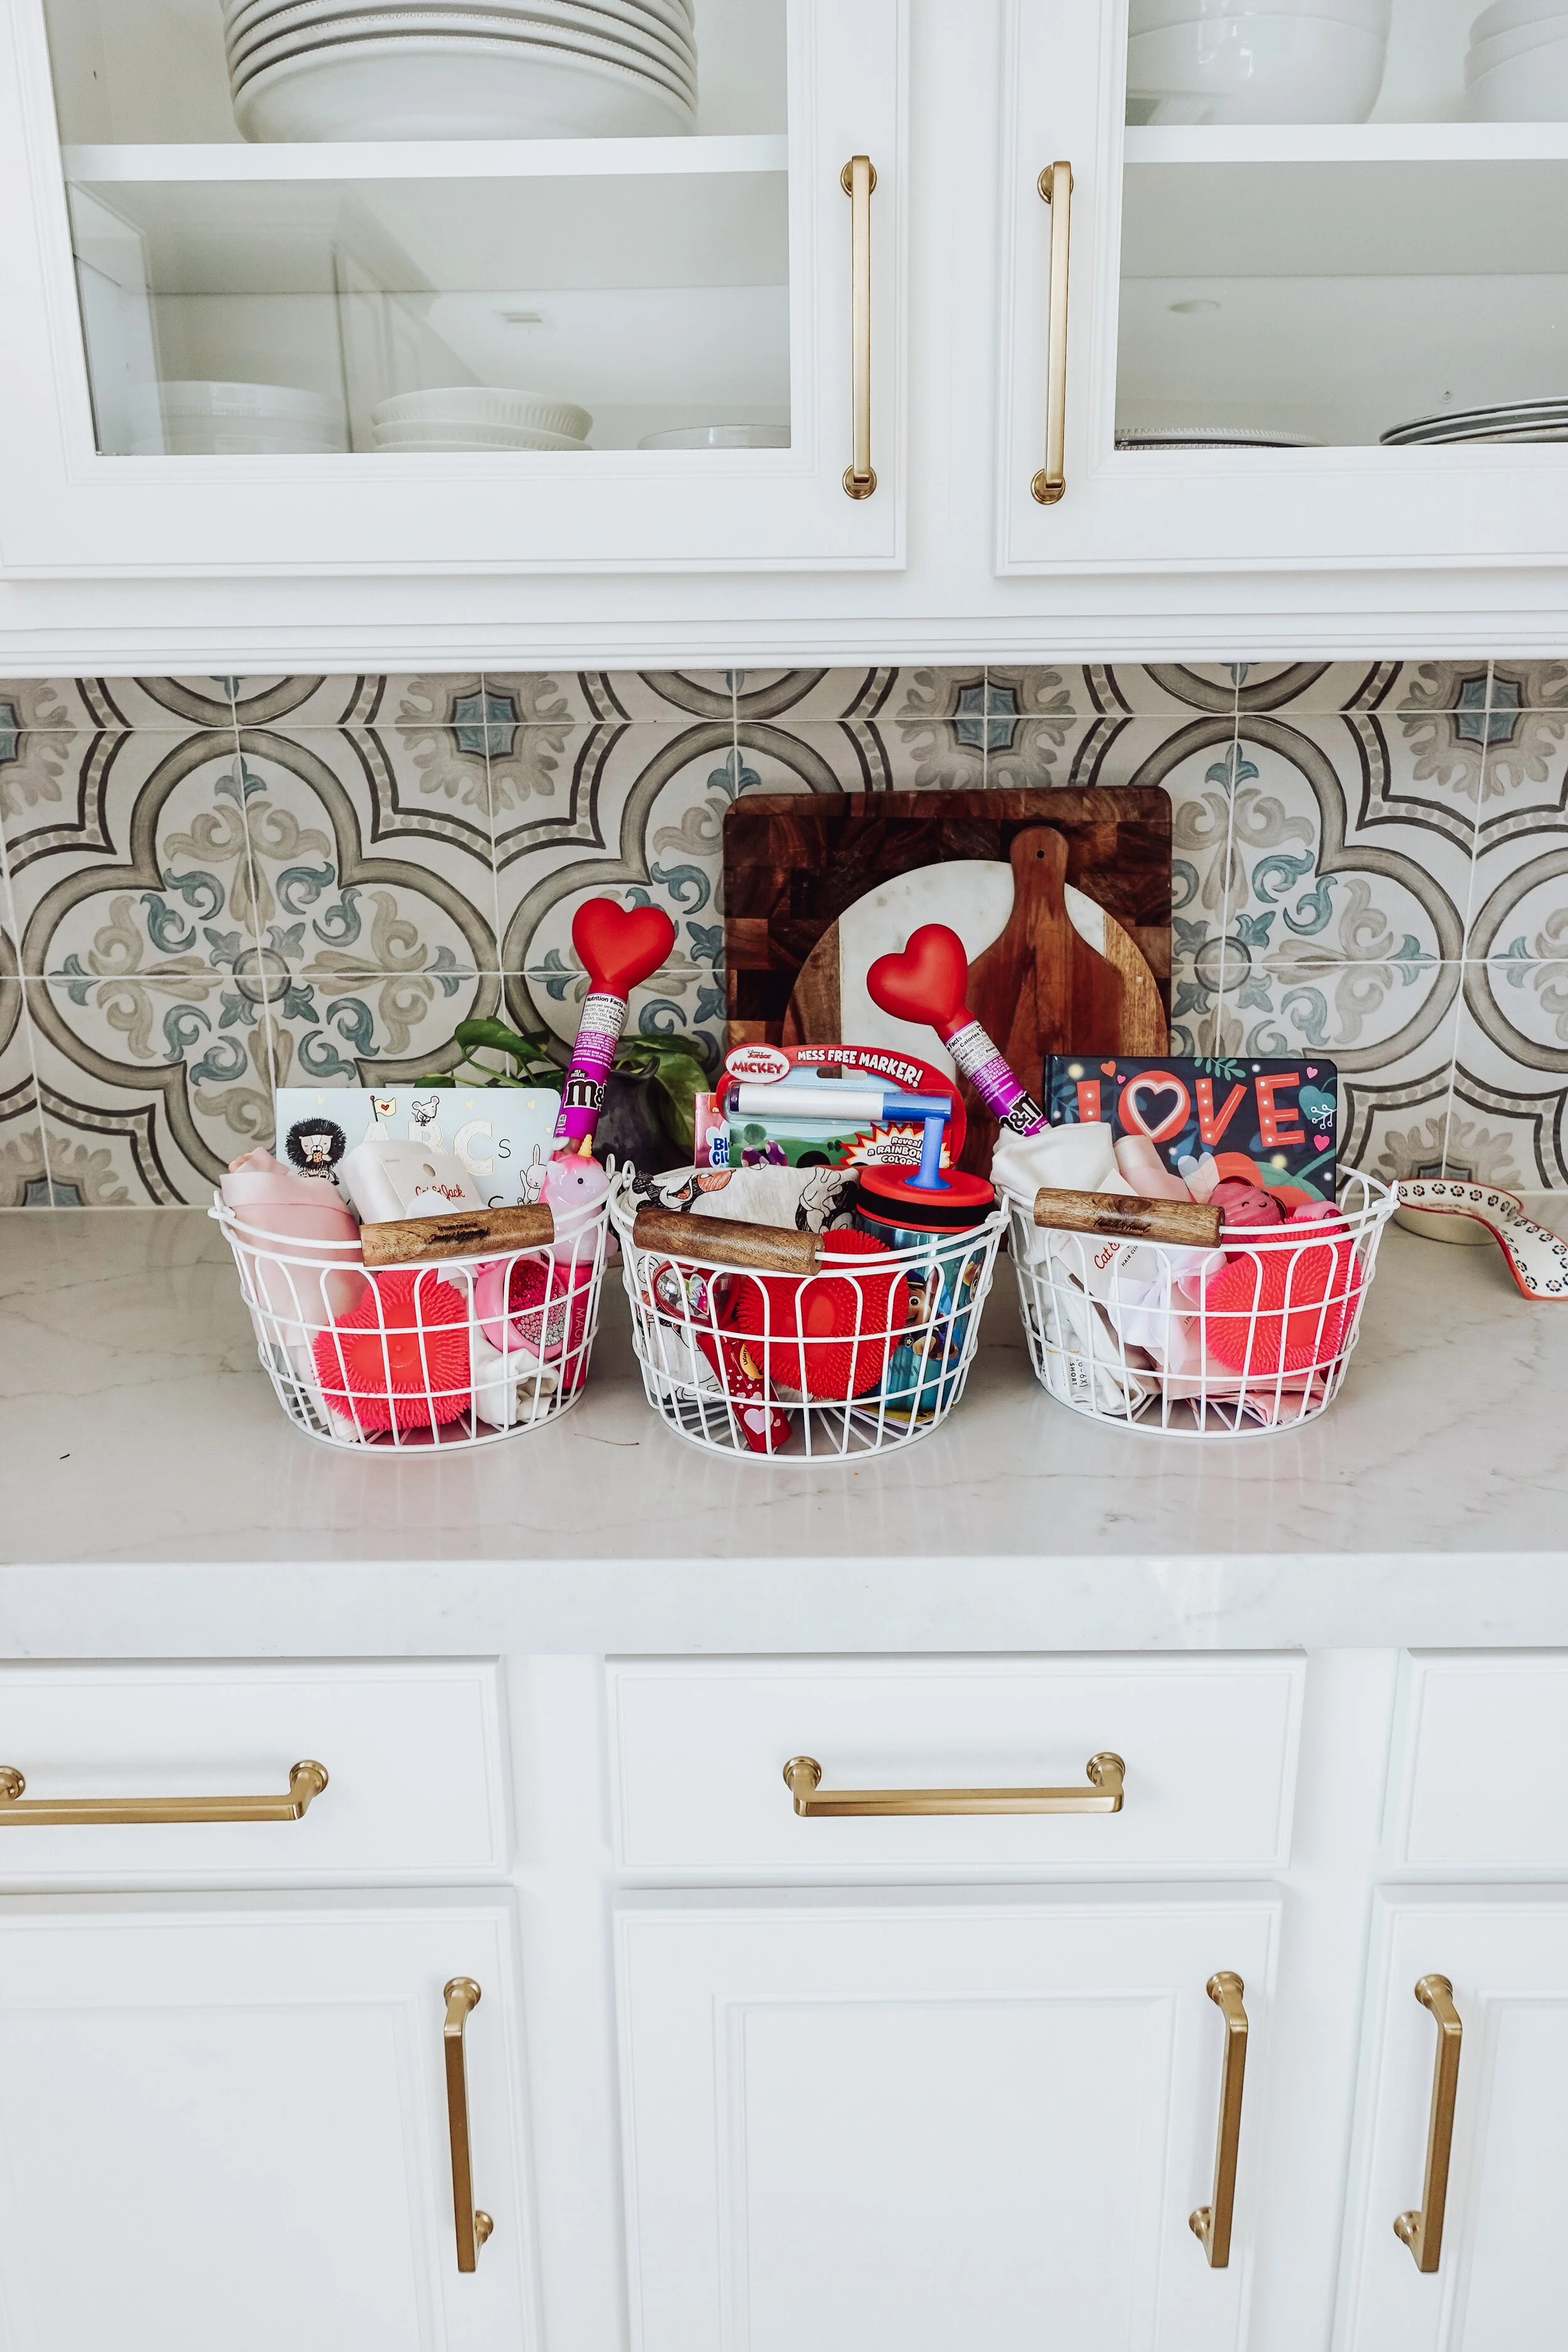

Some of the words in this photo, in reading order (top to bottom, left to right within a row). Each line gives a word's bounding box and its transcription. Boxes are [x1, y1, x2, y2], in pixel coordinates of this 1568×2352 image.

[948, 1036, 962, 1049] Facts
[960, 1032, 980, 1047] Calories
[731, 1061, 783, 1074] MICKEY
[798, 1050, 825, 1061] MESS
[827, 1049, 857, 1065] FREE
[859, 1053, 924, 1089] MARKER!
[564, 1079, 607, 1110] m&
[891, 1136, 923, 1148] Reveal
[441, 1184, 465, 1201] Jack
[1094, 1247, 1113, 1269] Cat
[1121, 1254, 1131, 1267] HAIR
[689, 1286, 706, 1299] OVE
